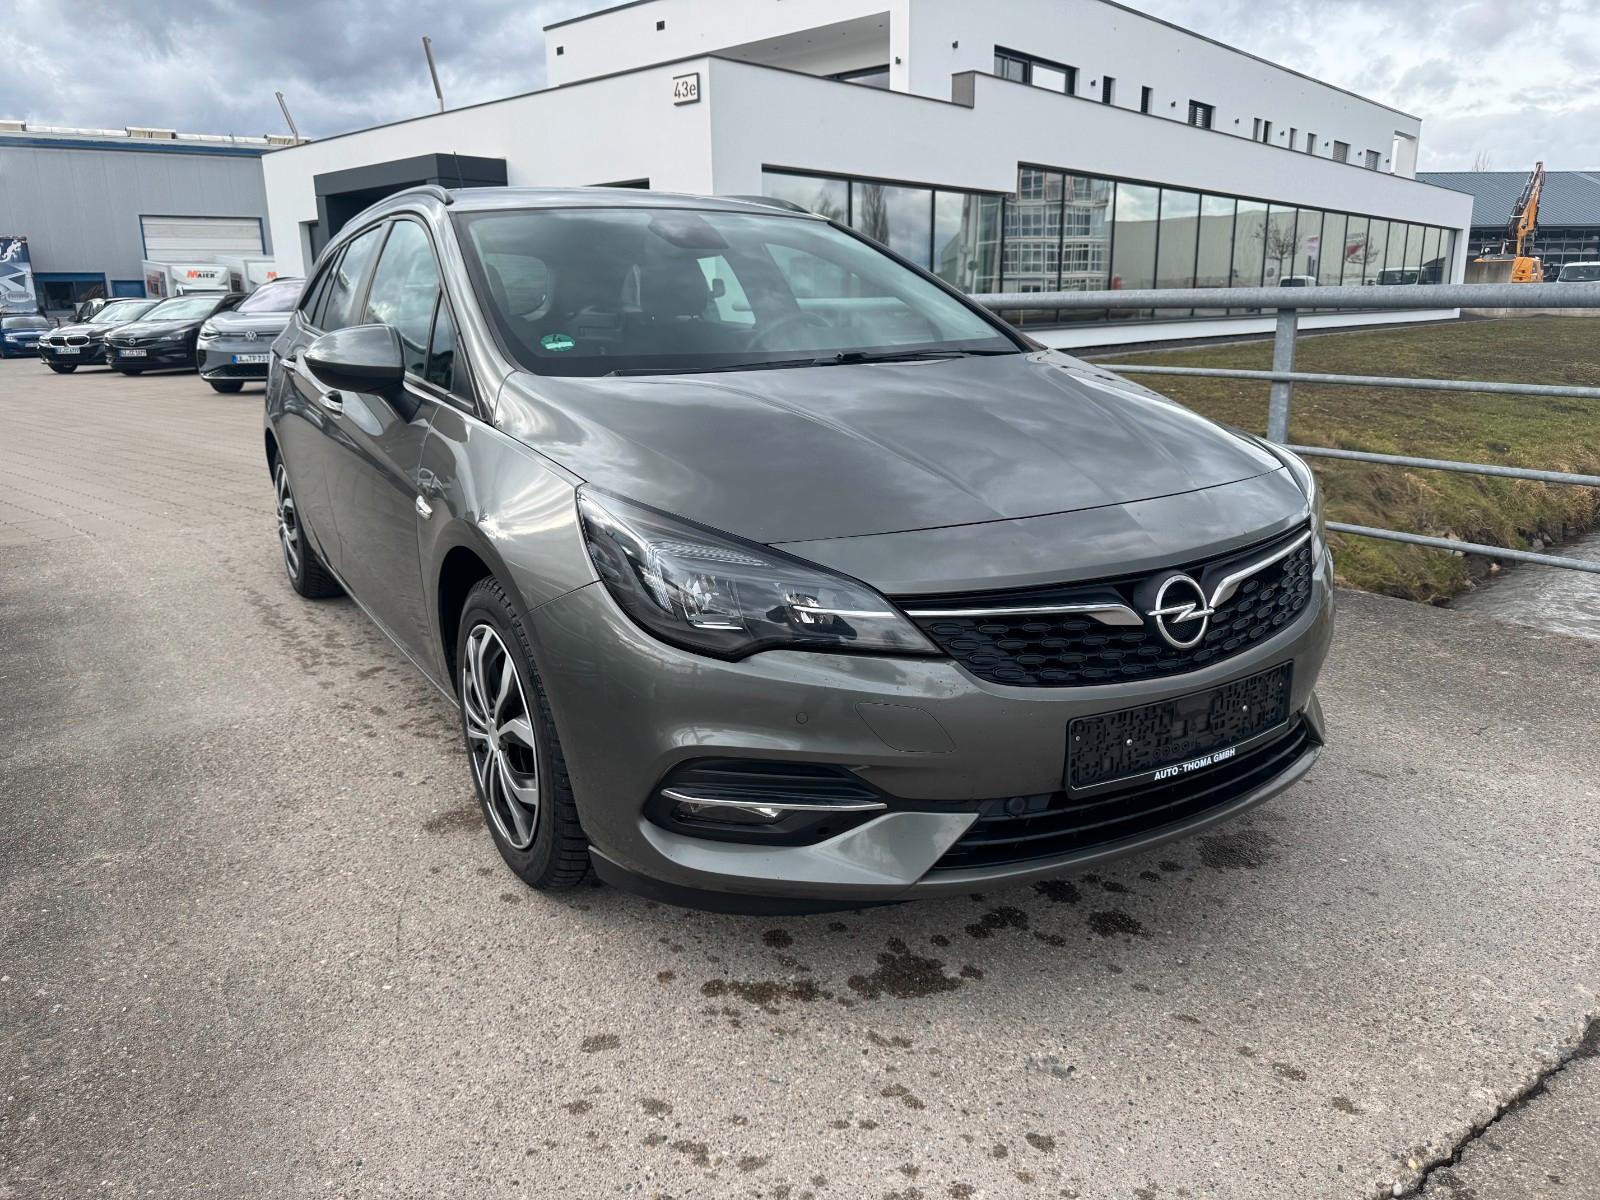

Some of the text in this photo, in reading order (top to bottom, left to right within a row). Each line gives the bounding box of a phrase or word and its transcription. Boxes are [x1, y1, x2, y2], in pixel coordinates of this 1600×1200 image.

[674, 79, 696, 99] 43e
[187, 270, 216, 279] MAIER
[1213, 747, 1236, 762] GMBH
